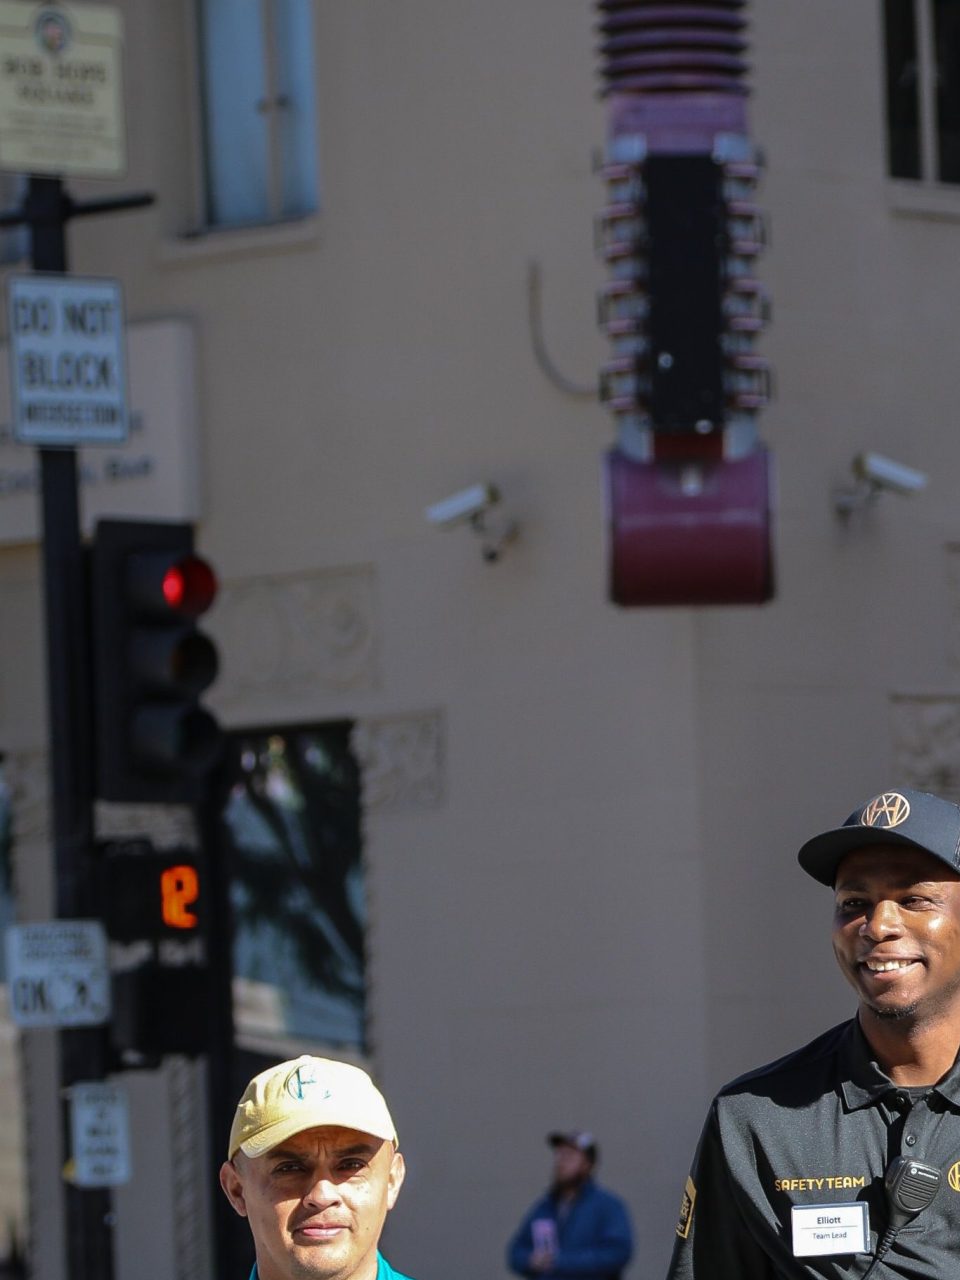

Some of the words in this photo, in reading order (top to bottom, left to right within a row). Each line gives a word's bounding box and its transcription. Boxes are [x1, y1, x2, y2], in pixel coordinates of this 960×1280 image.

[14, 299, 54, 336] DO
[62, 300, 115, 337] NOT
[22, 352, 113, 391] BLOCK
[774, 1178, 824, 1191] SAFETY
[825, 1176, 865, 1190] TEAM
[816, 1216, 842, 1225] Elliott
[812, 1232, 831, 1240] Team
[831, 1231, 848, 1239] Lead
